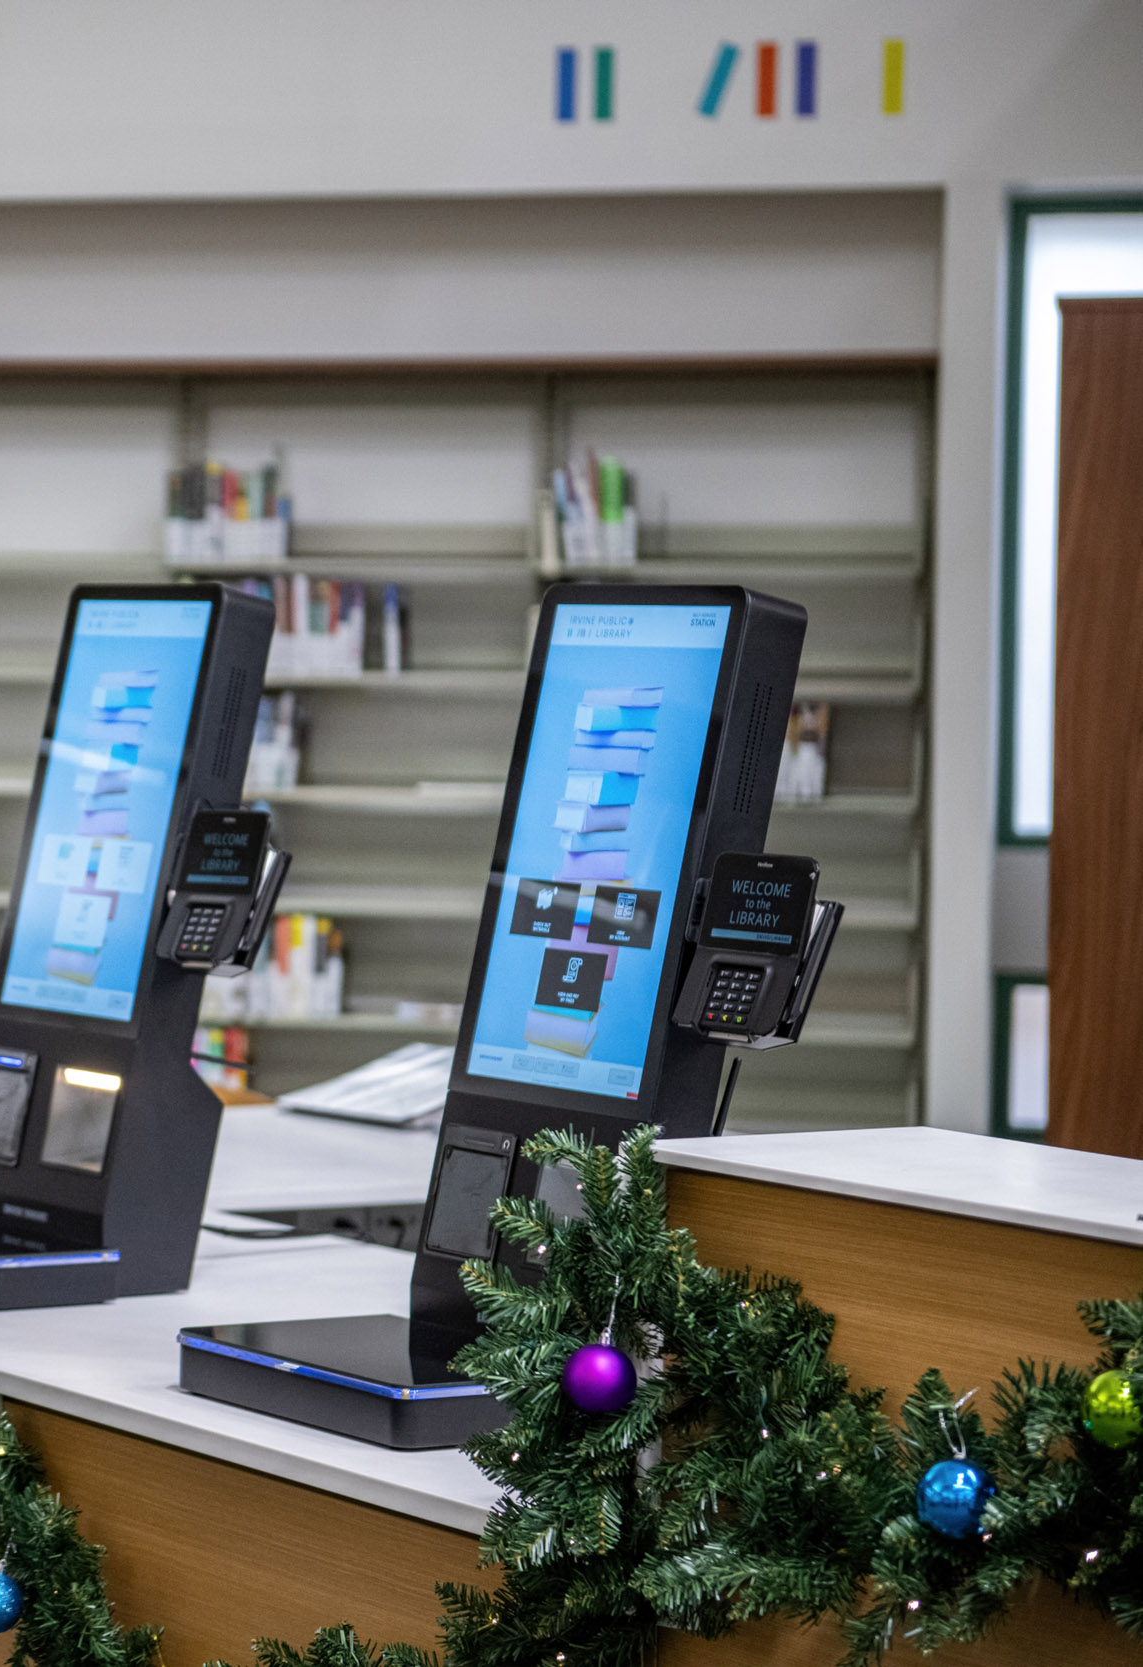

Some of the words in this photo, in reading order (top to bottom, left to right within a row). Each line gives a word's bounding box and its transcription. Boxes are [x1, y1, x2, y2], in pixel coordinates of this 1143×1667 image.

[569, 615, 596, 625] IRVINE
[598, 615, 628, 625] PUBLIC
[690, 619, 716, 627] STATION
[595, 628, 633, 638] LIBRARY
[203, 832, 250, 847] WELCOME
[200, 857, 240, 872] LIBRARY
[732, 879, 793, 898] WELCOME
[745, 898, 755, 908] to
[756, 898, 771, 910] the
[729, 910, 780, 928] LIBRARY
